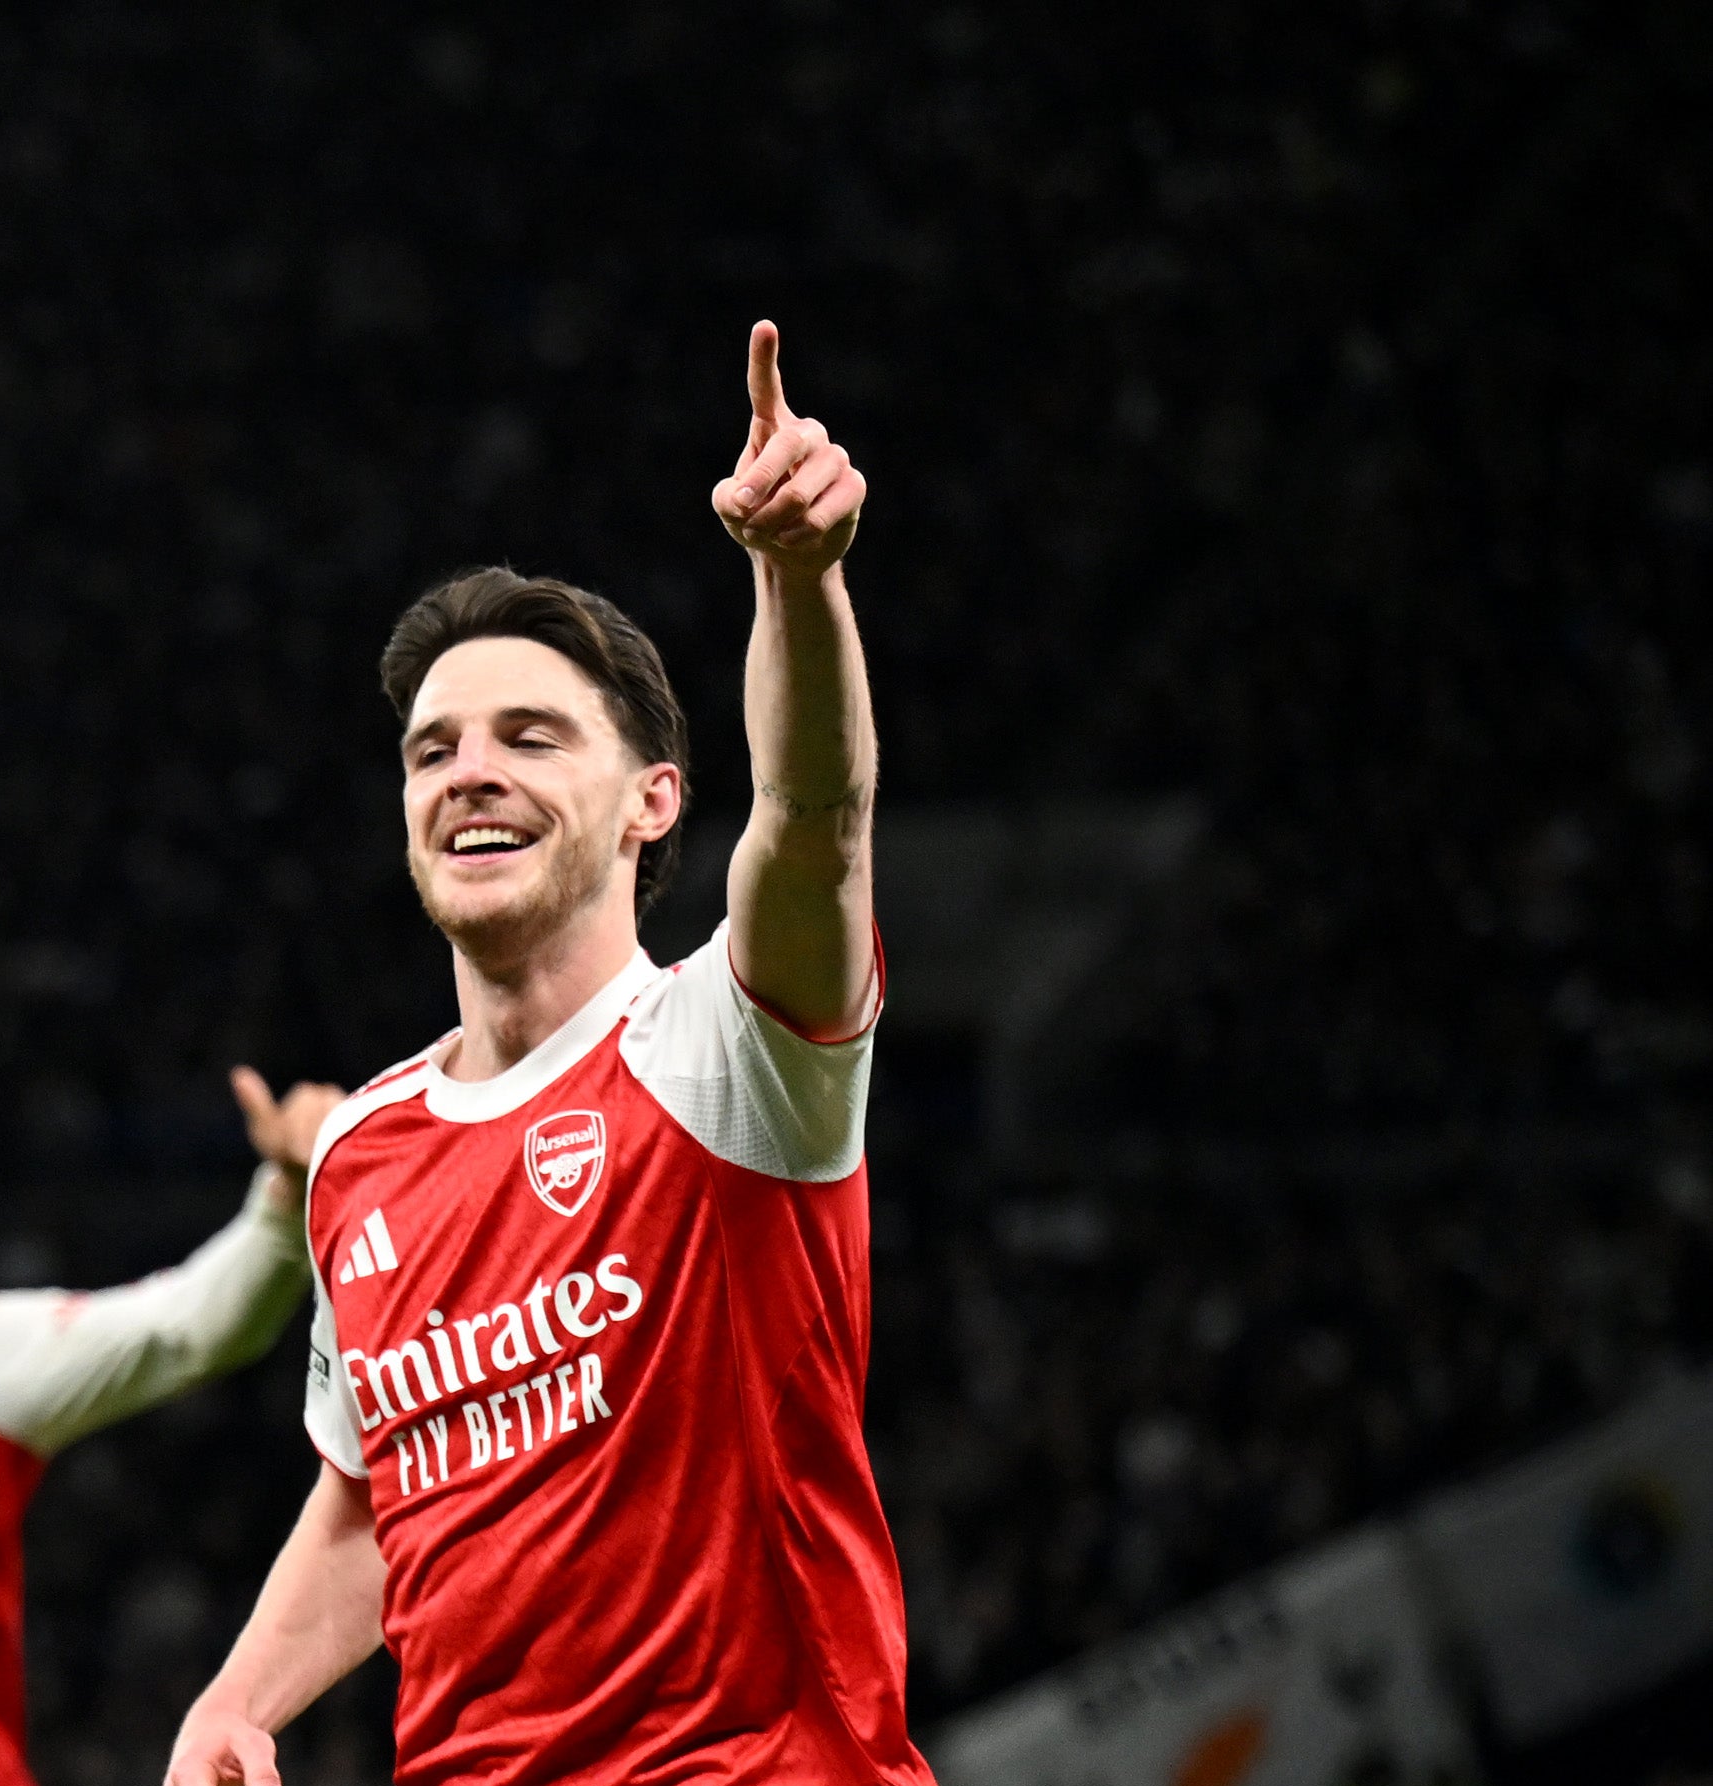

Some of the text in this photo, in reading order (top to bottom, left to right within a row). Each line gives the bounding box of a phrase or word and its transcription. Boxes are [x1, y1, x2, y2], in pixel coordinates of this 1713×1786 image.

[535, 1124, 594, 1155] Arsenal
[342, 1253, 643, 1432] Emirates
[391, 1353, 614, 1497] FLY BETTER
